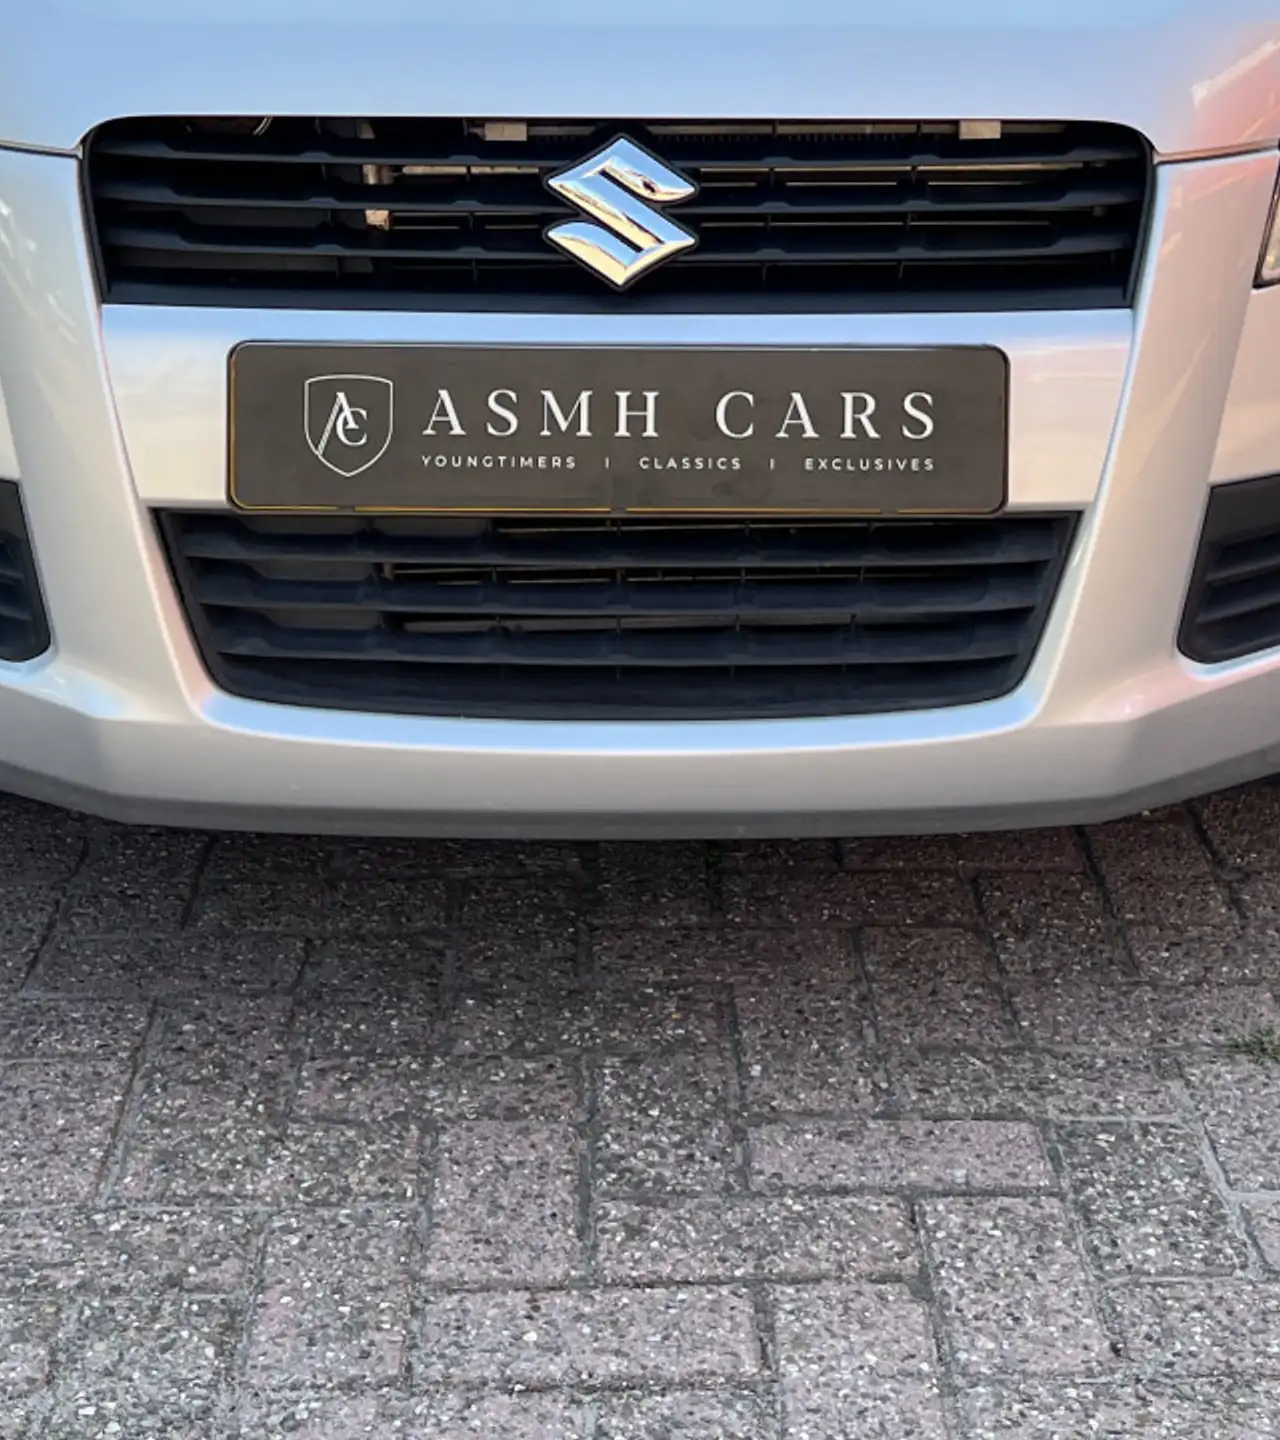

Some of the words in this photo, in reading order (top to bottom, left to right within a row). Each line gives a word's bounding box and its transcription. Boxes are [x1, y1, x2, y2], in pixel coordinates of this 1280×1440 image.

[422, 389, 660, 438] ASMH
[715, 390, 935, 440] CARS
[421, 455, 576, 470] YOUNGTIMERS
[639, 456, 741, 470] CLASSICS
[804, 458, 934, 472] EXCLUSIVES
